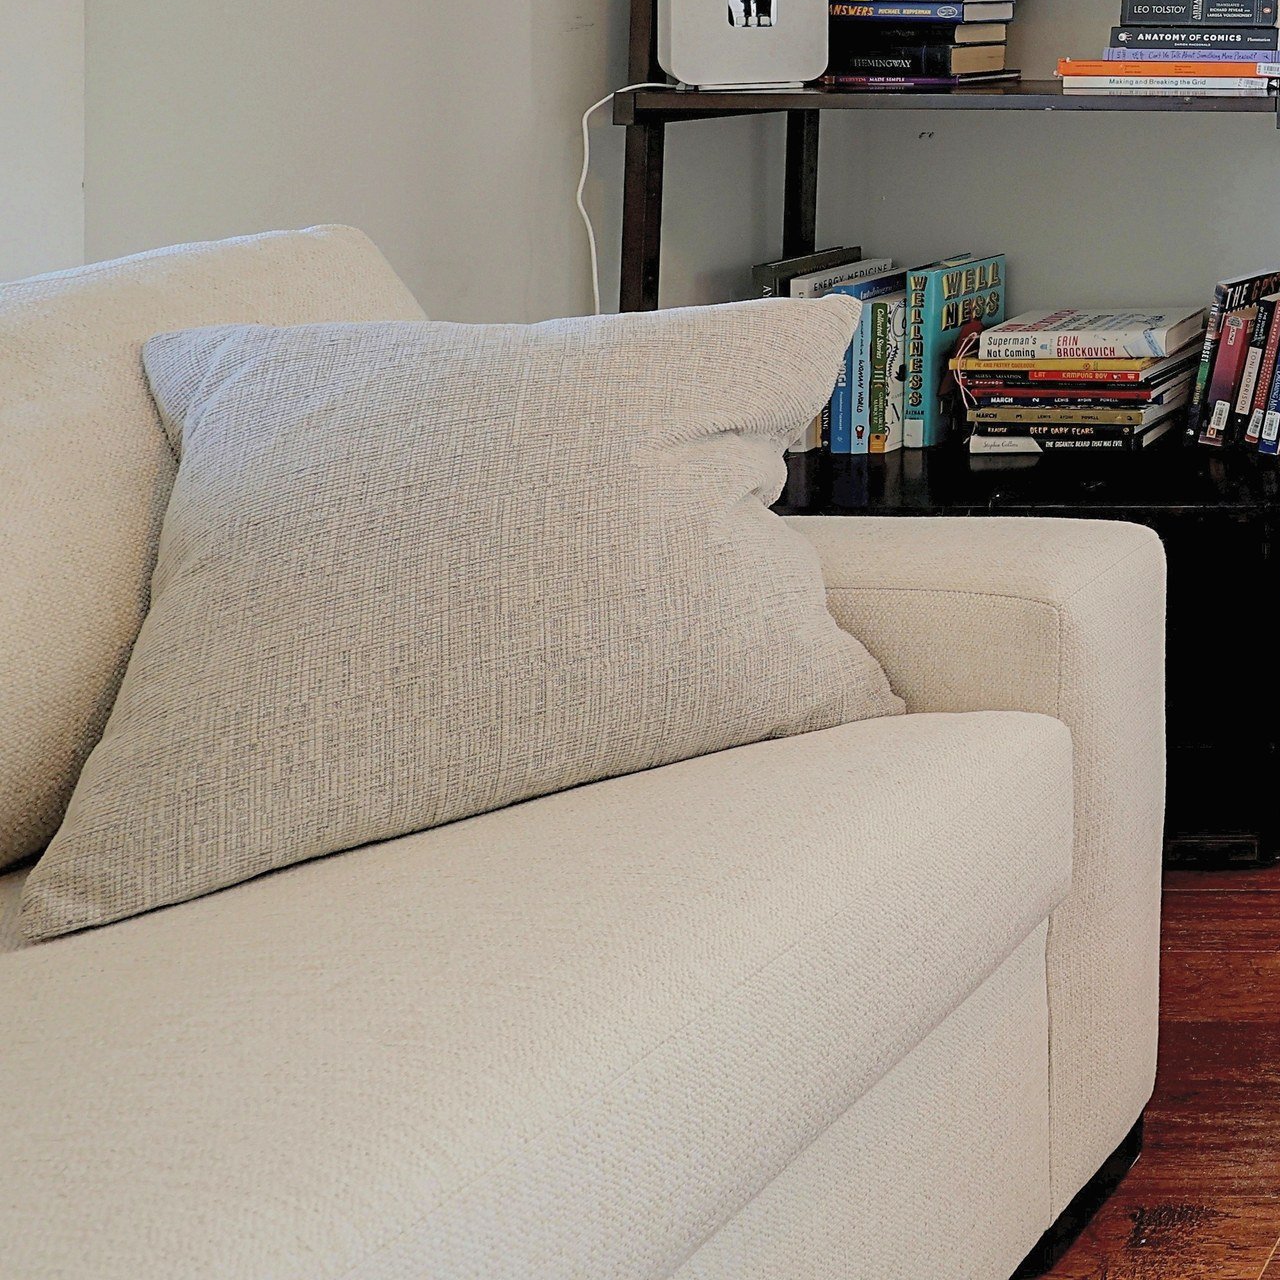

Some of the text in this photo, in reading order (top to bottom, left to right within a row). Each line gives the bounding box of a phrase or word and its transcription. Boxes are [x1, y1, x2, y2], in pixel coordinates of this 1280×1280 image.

[1134, 5, 1187, 14] LEO TOLSTOY
[1137, 33, 1187, 42] ANATOMY
[1189, 34, 1202, 42] OF
[1203, 33, 1242, 42] COMICS
[854, 58, 912, 68] HEMINGWAY
[1109, 78, 1134, 86] Making
[1149, 79, 1178, 87] Breaking
[813, 264, 888, 292] ENERGY MEDICINE
[941, 261, 1001, 299] WELL
[1225, 283, 1250, 309] THE
[941, 291, 1000, 331] NESS
[1210, 301, 1219, 318] THE
[874, 308, 885, 360] Collected Stories
[1227, 326, 1235, 346] JUNG
[988, 336, 1037, 347] Superman's
[1057, 336, 1079, 347] ERIN
[987, 348, 1036, 359] Not Coming
[1056, 346, 1116, 358] BROCKOVICH
[1250, 351, 1258, 368] TONI
[857, 359, 866, 390] WOMAN
[1240, 368, 1253, 412] MORRISON
[990, 396, 1013, 404] MARCH
[1029, 426, 1048, 435] DEEP
[1050, 427, 1069, 435] DARK
[1071, 427, 1094, 435] FEARS
